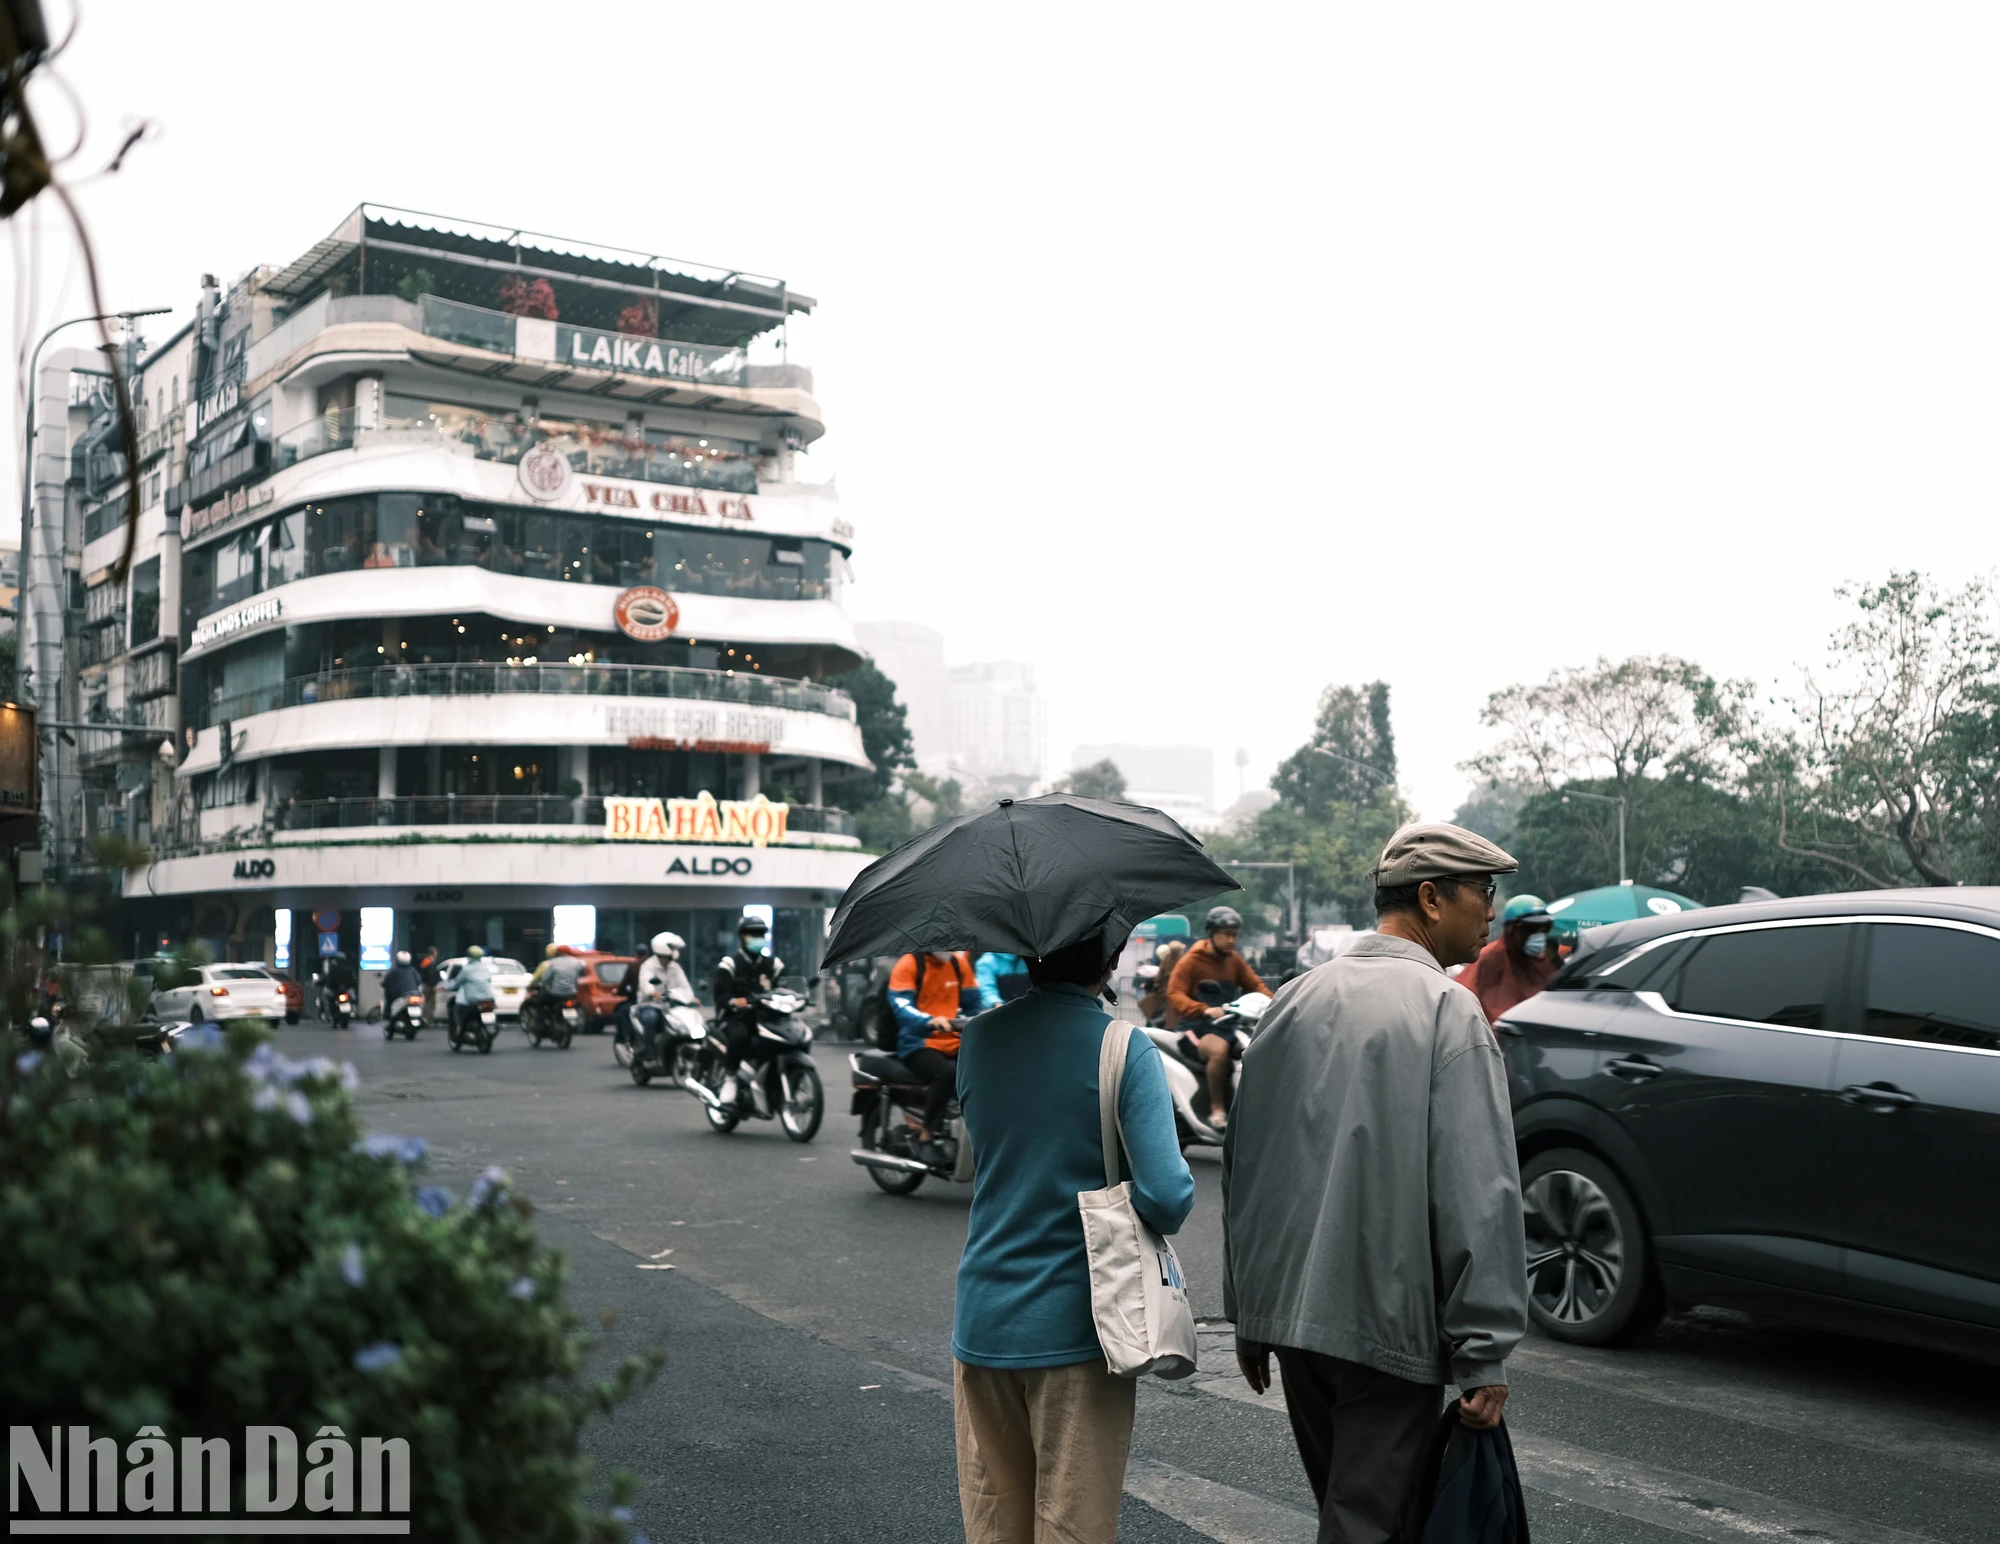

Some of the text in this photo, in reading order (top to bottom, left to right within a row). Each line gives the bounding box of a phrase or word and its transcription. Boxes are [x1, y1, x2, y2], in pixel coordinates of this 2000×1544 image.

[573, 332, 705, 377] LAIKA Café
[583, 483, 639, 508] VUA
[718, 494, 753, 520] CÁ
[241, 598, 281, 628] COFFEE
[606, 798, 668, 838] BIA
[723, 794, 788, 847] NỘI
[234, 859, 275, 878] ALDO
[666, 857, 752, 875] ALDO
[413, 888, 463, 902] ALDO
